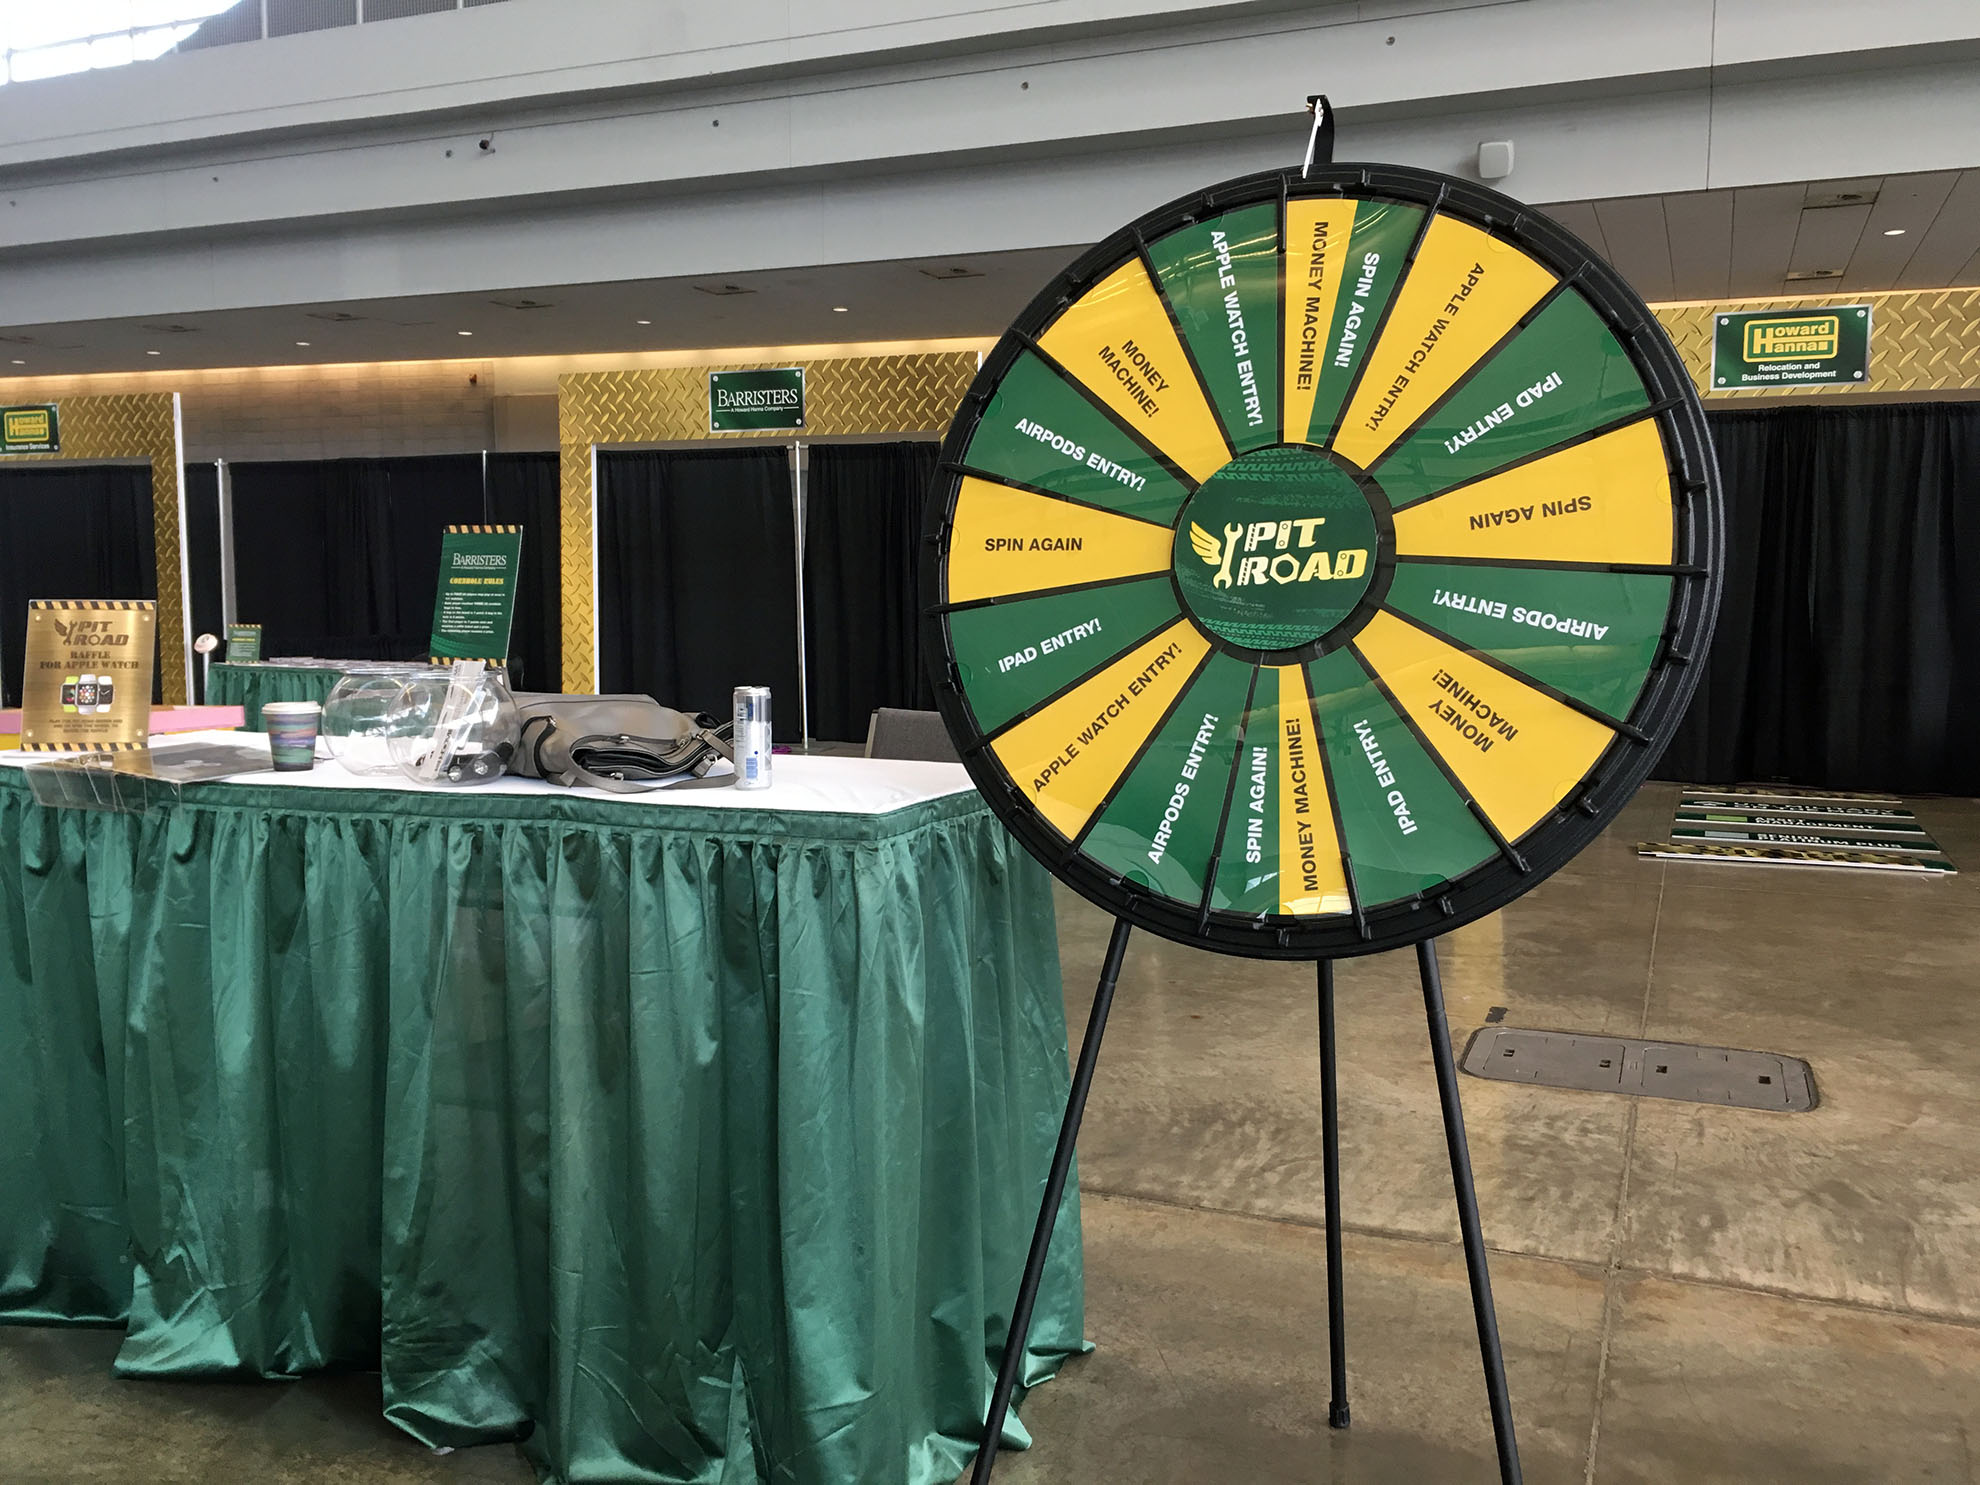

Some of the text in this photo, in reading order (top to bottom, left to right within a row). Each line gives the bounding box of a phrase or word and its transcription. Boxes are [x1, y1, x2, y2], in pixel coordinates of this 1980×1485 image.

[1210, 231, 1264, 427] APPLE WATCH ENTRY!
[1296, 221, 1329, 392] MONEY MACHINE!
[1334, 251, 1381, 369] SPIN AGAIN!
[1753, 321, 1830, 342] Howard
[1121, 340, 1170, 392] MONEY
[1364, 262, 1486, 432] APPLE WATCH ENTRY!
[1758, 361, 1821, 372] Relocation and
[717, 388, 799, 407] BARRISTERS
[1098, 346, 1161, 419] MACHINE!
[1741, 370, 1837, 382] Business Development
[1443, 371, 1564, 455] IPAD ENTRY!
[1015, 417, 1147, 492] AIRPODS ENTRY!
[1243, 517, 1326, 552] PIT
[1469, 494, 1593, 531] SPIN AGAIN
[453, 553, 506, 566] BARRISTERS
[984, 537, 1083, 552] SPIN AGAIN
[1236, 548, 1369, 587] ROAD
[72, 634, 130, 646] ROAD
[77, 621, 113, 633] PIT
[1432, 588, 1610, 641] AIRPODS ENTRY!
[39, 660, 140, 670] FOR APPLE WATCH
[70, 650, 111, 659] RAFFLE
[997, 617, 1103, 674] IPAD ENTRY!
[1031, 641, 1183, 794] APPLE WATCH ENTRY!
[1427, 700, 1494, 754] MONEY
[1431, 667, 1520, 742] MACHINE!
[1145, 712, 1220, 866] AIRPODS ENTRY!
[1352, 718, 1418, 836] IPAD ENTRY!
[1245, 746, 1268, 864] SPIN AGAIN!
[1285, 717, 1319, 892] MONEY MACHINE!
[1755, 820, 1874, 829] MANAGEMENT
